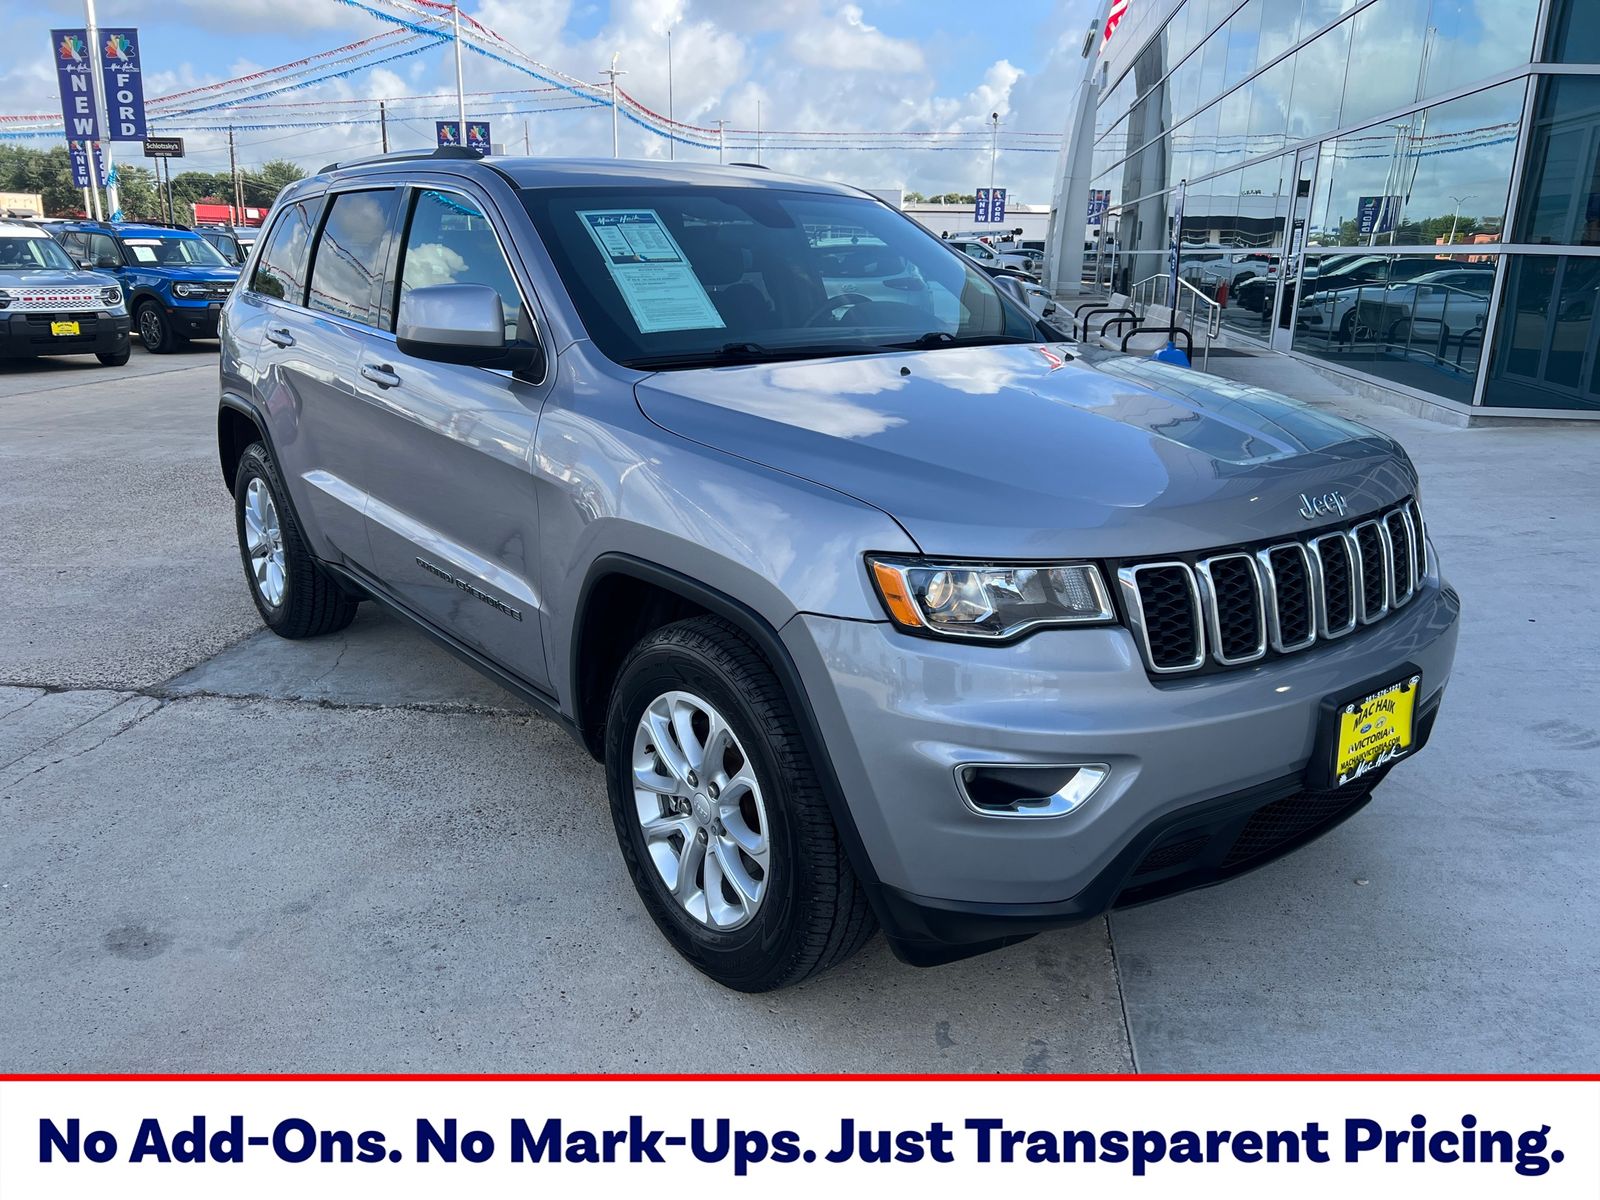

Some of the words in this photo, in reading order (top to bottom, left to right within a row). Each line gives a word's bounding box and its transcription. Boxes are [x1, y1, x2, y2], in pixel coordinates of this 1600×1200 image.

[71, 74, 93, 136] NEW
[116, 74, 136, 136] FORD
[76, 156, 88, 185] NEW
[978, 202, 986, 221] NEW
[1299, 491, 1348, 520] Jeep
[1353, 703, 1375, 732] MAC
[1375, 698, 1396, 714] HAIK
[1354, 728, 1389, 752] VICTORIA
